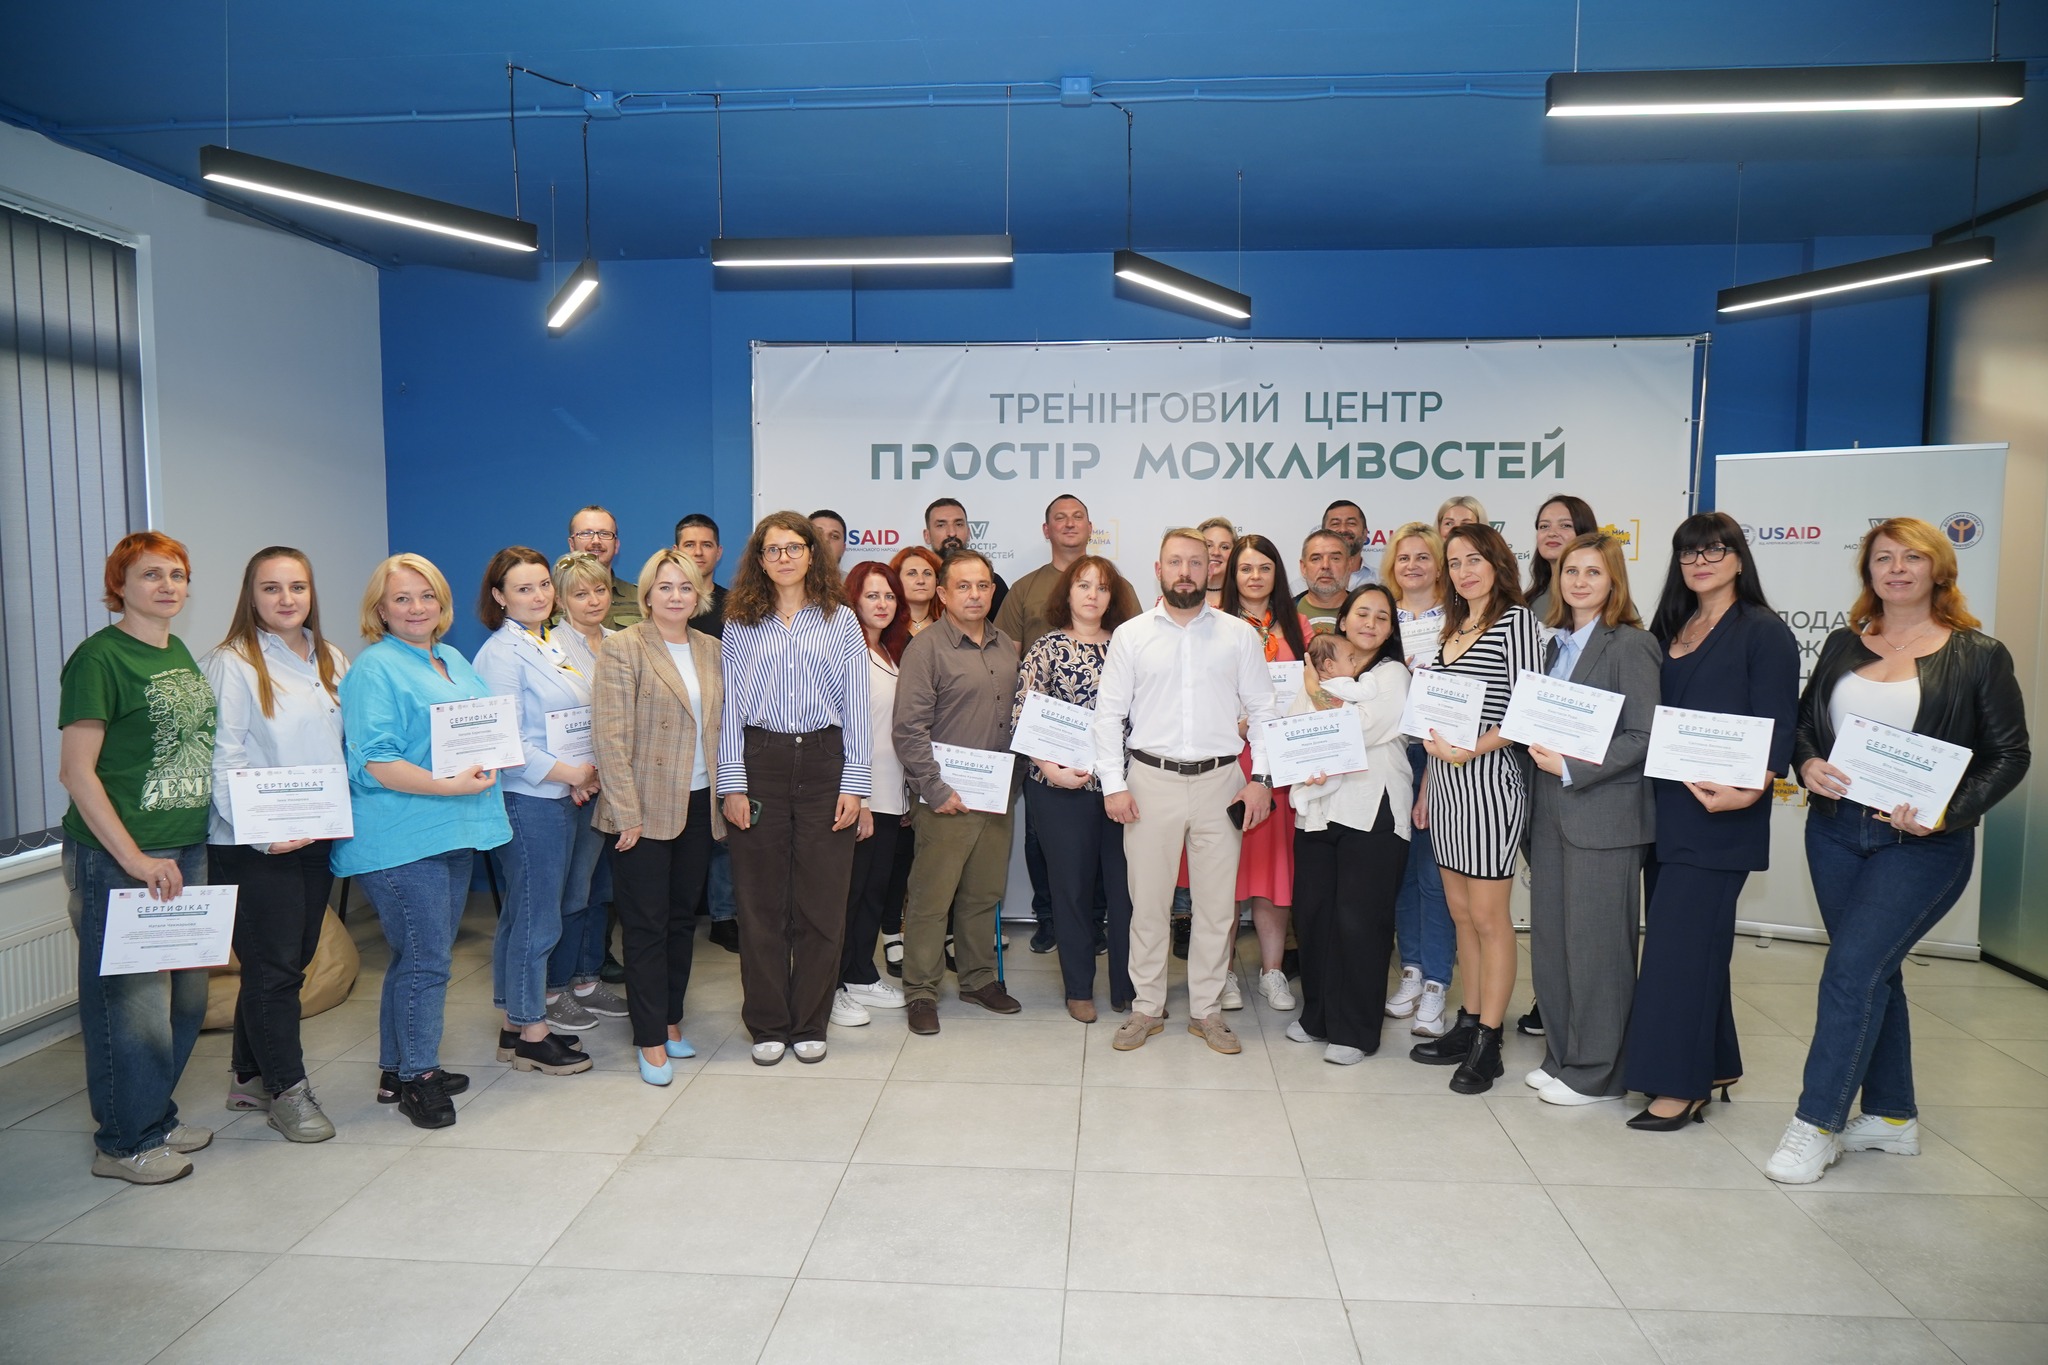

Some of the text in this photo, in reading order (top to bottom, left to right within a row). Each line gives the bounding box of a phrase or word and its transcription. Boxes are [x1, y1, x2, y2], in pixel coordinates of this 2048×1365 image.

[990, 383, 1443, 430] ТРЕНІНГОВИЙ ЦЕНТР
[871, 426, 1566, 481] ПРОСТІР МОЖЛИВОСТЕЙ
[847, 529, 900, 546] SAID
[1758, 526, 1821, 540] USAID
[966, 542, 998, 550] РОСТІР
[1088, 537, 1111, 545] РАЇНА
[1427, 685, 1470, 699] СЕРТИФІКАТ
[1537, 690, 1598, 710] СЕРТИФІКАТ
[450, 712, 498, 724] СЕРТИФІКАТ
[564, 720, 592, 730] СЕРТИФ
[1041, 708, 1089, 728] СЕРТИФІКАТ
[1284, 723, 1340, 738] СЕРТИФІКАТ
[1678, 724, 1746, 737] СЕРТИФІКАТ
[1866, 739, 1938, 767] СЕРТИФІКАТ
[944, 758, 994, 770] СЕРТИФІКАТ
[256, 780, 324, 790] СЕРТИФІКАТ
[137, 903, 211, 914] СЕРТИФІКАТ
